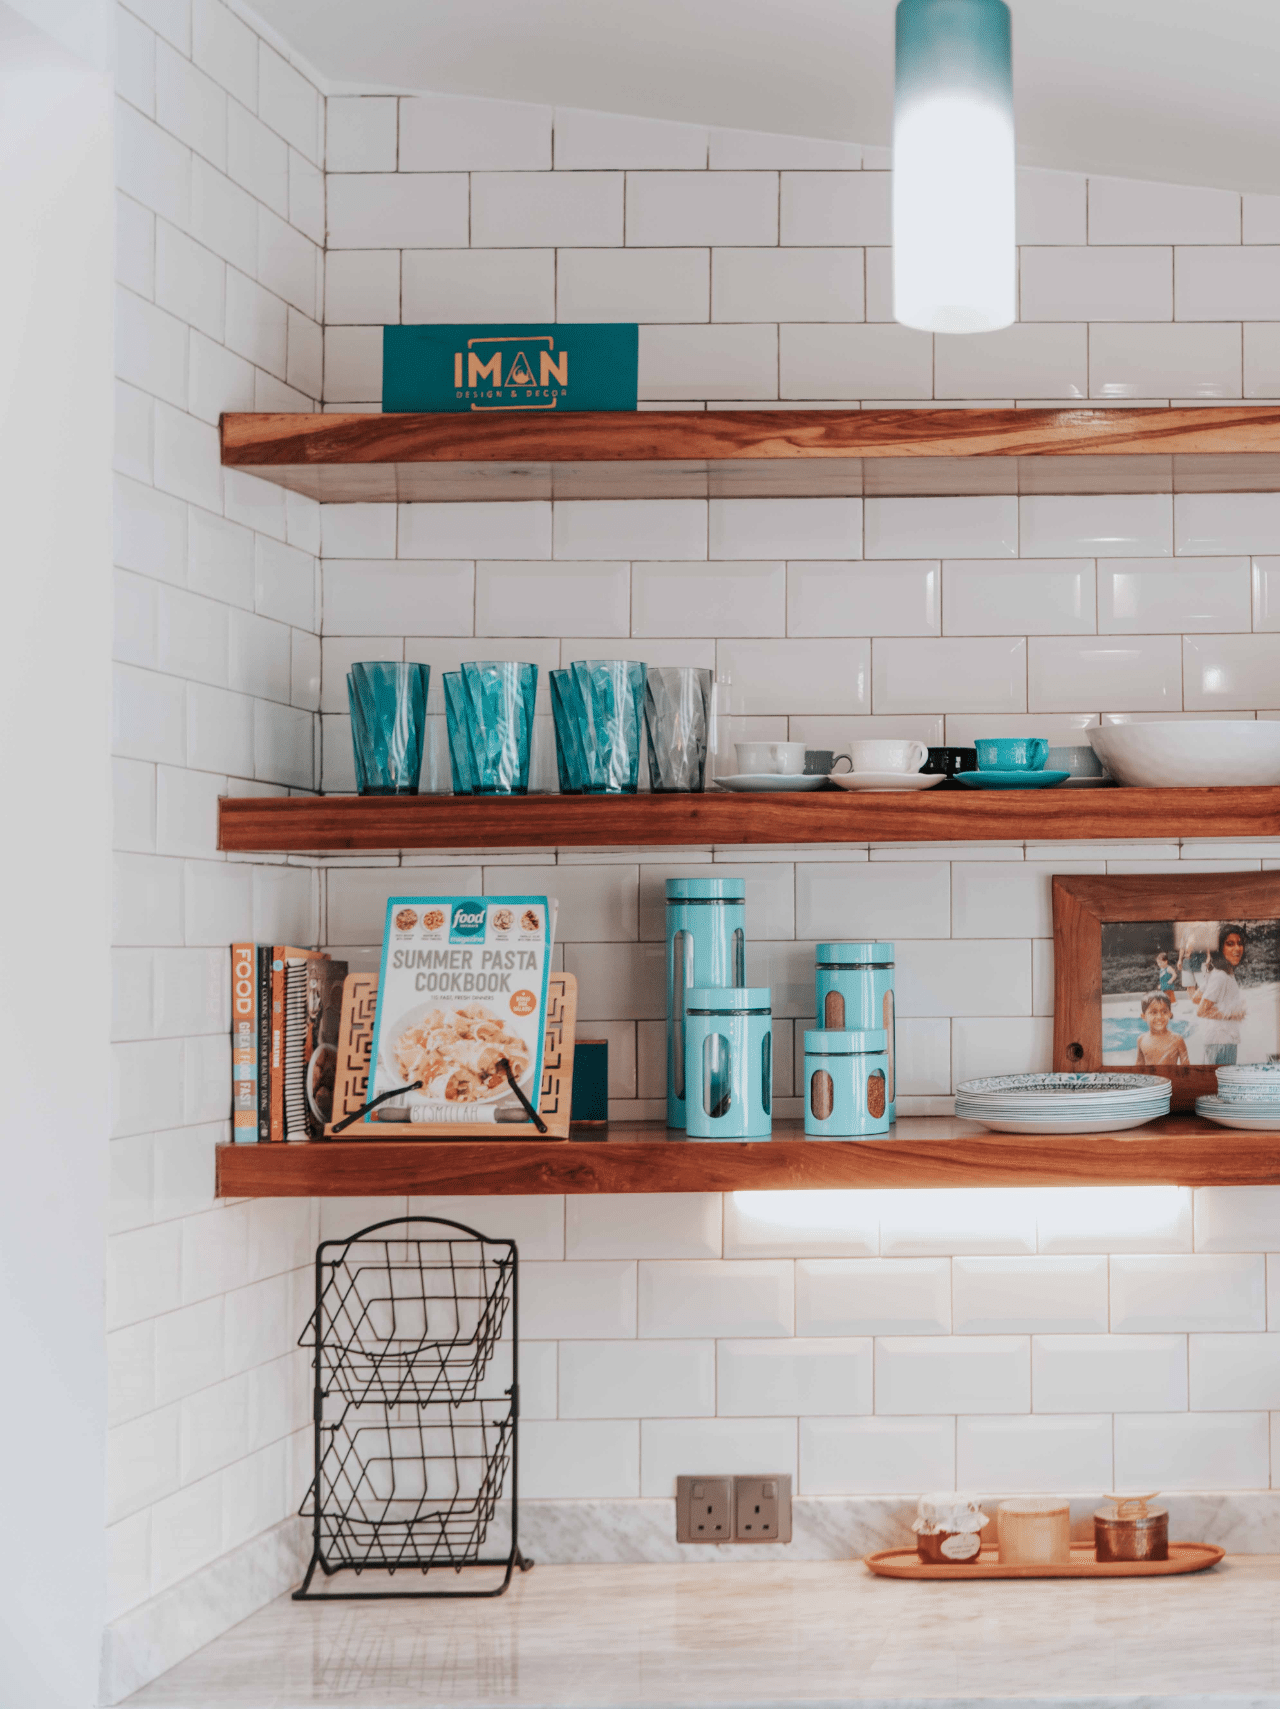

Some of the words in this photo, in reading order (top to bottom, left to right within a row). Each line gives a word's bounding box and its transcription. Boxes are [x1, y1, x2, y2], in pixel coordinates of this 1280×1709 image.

[454, 351, 568, 388] IMAN
[456, 390, 503, 399] DESIGN
[510, 390, 517, 398] &
[526, 389, 567, 398] DECOR
[452, 909, 485, 928] food
[393, 949, 473, 970] SUMMER
[481, 950, 537, 970] PASTA
[235, 948, 252, 1014] FOOD
[415, 972, 511, 993] COOKBOOK
[239, 1021, 251, 1052] GREAT
[239, 1054, 251, 1080] FOOD
[239, 1082, 251, 1106] FAST
[412, 1105, 479, 1122] BISMILLAH
